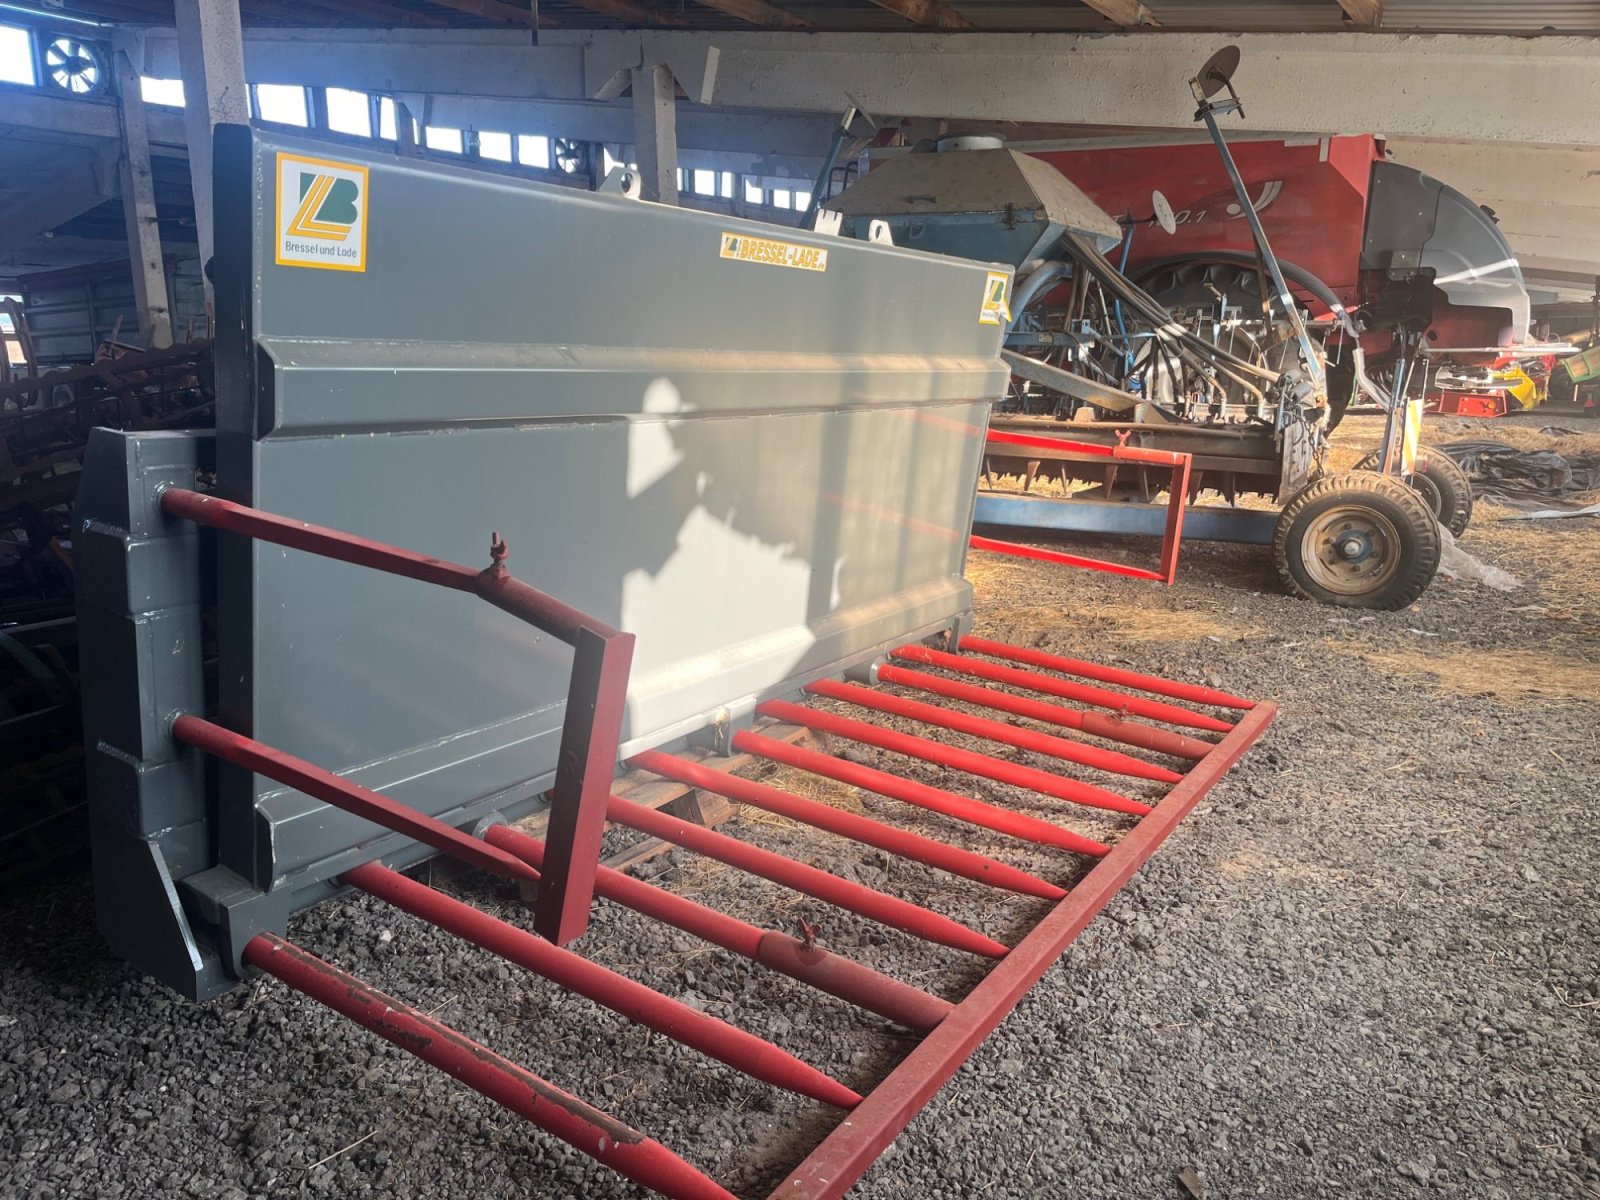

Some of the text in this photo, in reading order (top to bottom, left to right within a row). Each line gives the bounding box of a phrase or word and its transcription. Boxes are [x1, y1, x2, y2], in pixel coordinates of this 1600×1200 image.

[285, 241, 357, 258] Bressel und Lade
